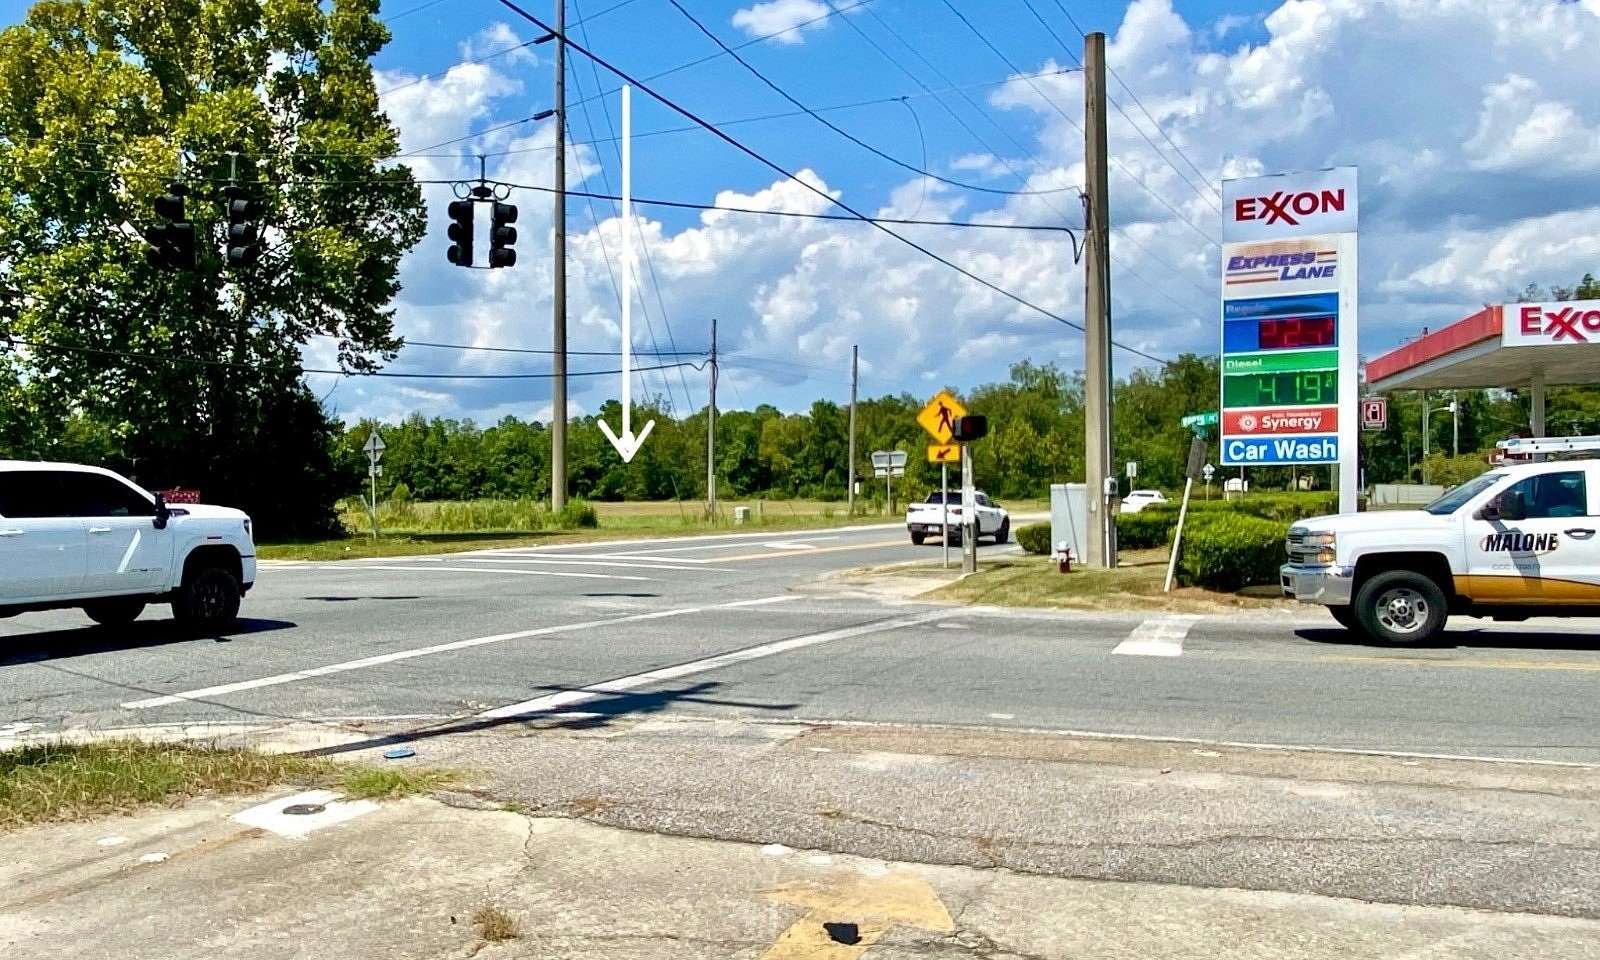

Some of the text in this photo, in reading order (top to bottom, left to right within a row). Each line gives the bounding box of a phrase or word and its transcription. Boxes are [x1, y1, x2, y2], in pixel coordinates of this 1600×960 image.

[1235, 188, 1345, 226] EXXON
[1227, 252, 1316, 271] EXPRESS
[1280, 265, 1337, 281] LANE
[1226, 359, 1262, 369] Diesel
[1262, 415, 1322, 431] Synergy
[1229, 439, 1337, 461] Car Wash
[1485, 533, 1558, 552] MALONE
